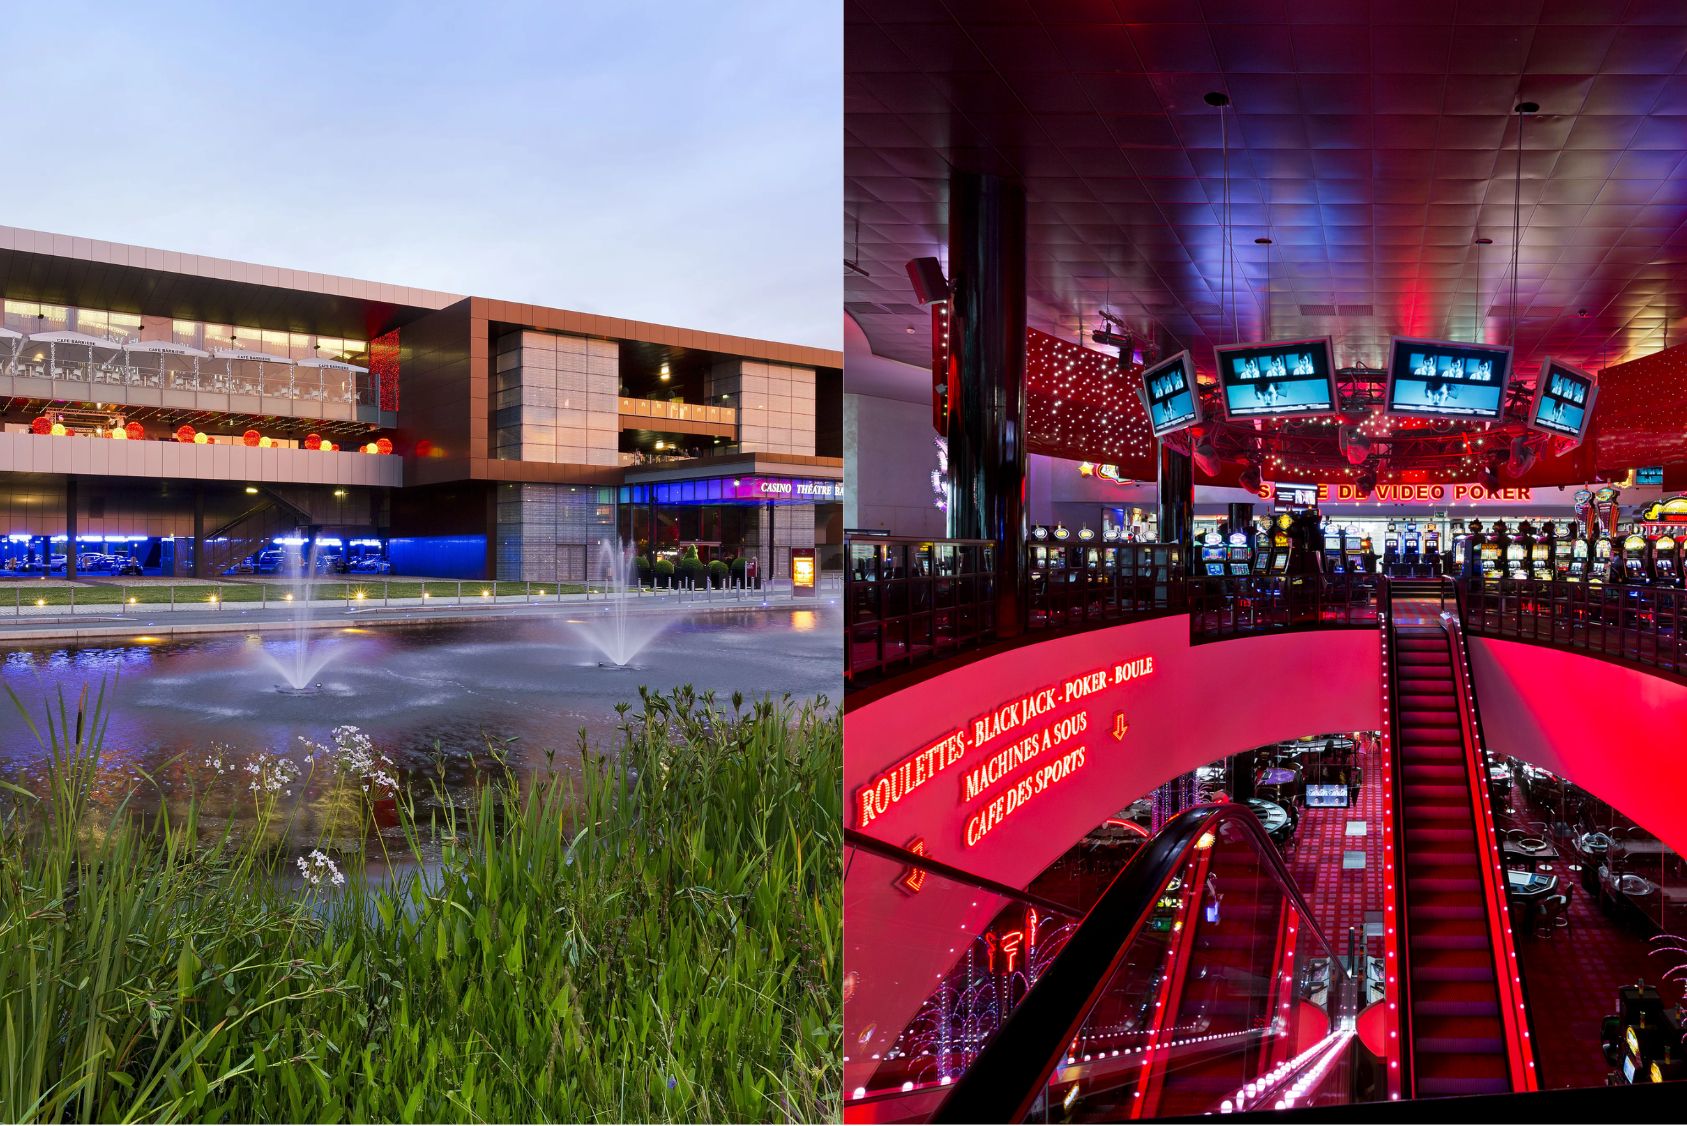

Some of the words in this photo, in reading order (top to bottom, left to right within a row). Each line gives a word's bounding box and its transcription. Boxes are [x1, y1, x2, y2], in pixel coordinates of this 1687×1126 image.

[761, 482, 792, 493] CASINO
[1375, 484, 1445, 501] VIDEO
[862, 730, 965, 828] ROULETTES
[975, 702, 1020, 748] BLACK
[1022, 688, 1056, 726] JACK
[1065, 671, 1107, 703] POKER
[1115, 656, 1153, 684] BOULE
[965, 733, 1039, 803] MACHINES
[1041, 728, 1052, 752] A
[1053, 711, 1087, 745] SOUS
[967, 795, 1005, 847] CAFE
[1006, 776, 1033, 816] DES
[1035, 746, 1086, 794] SPORTS
